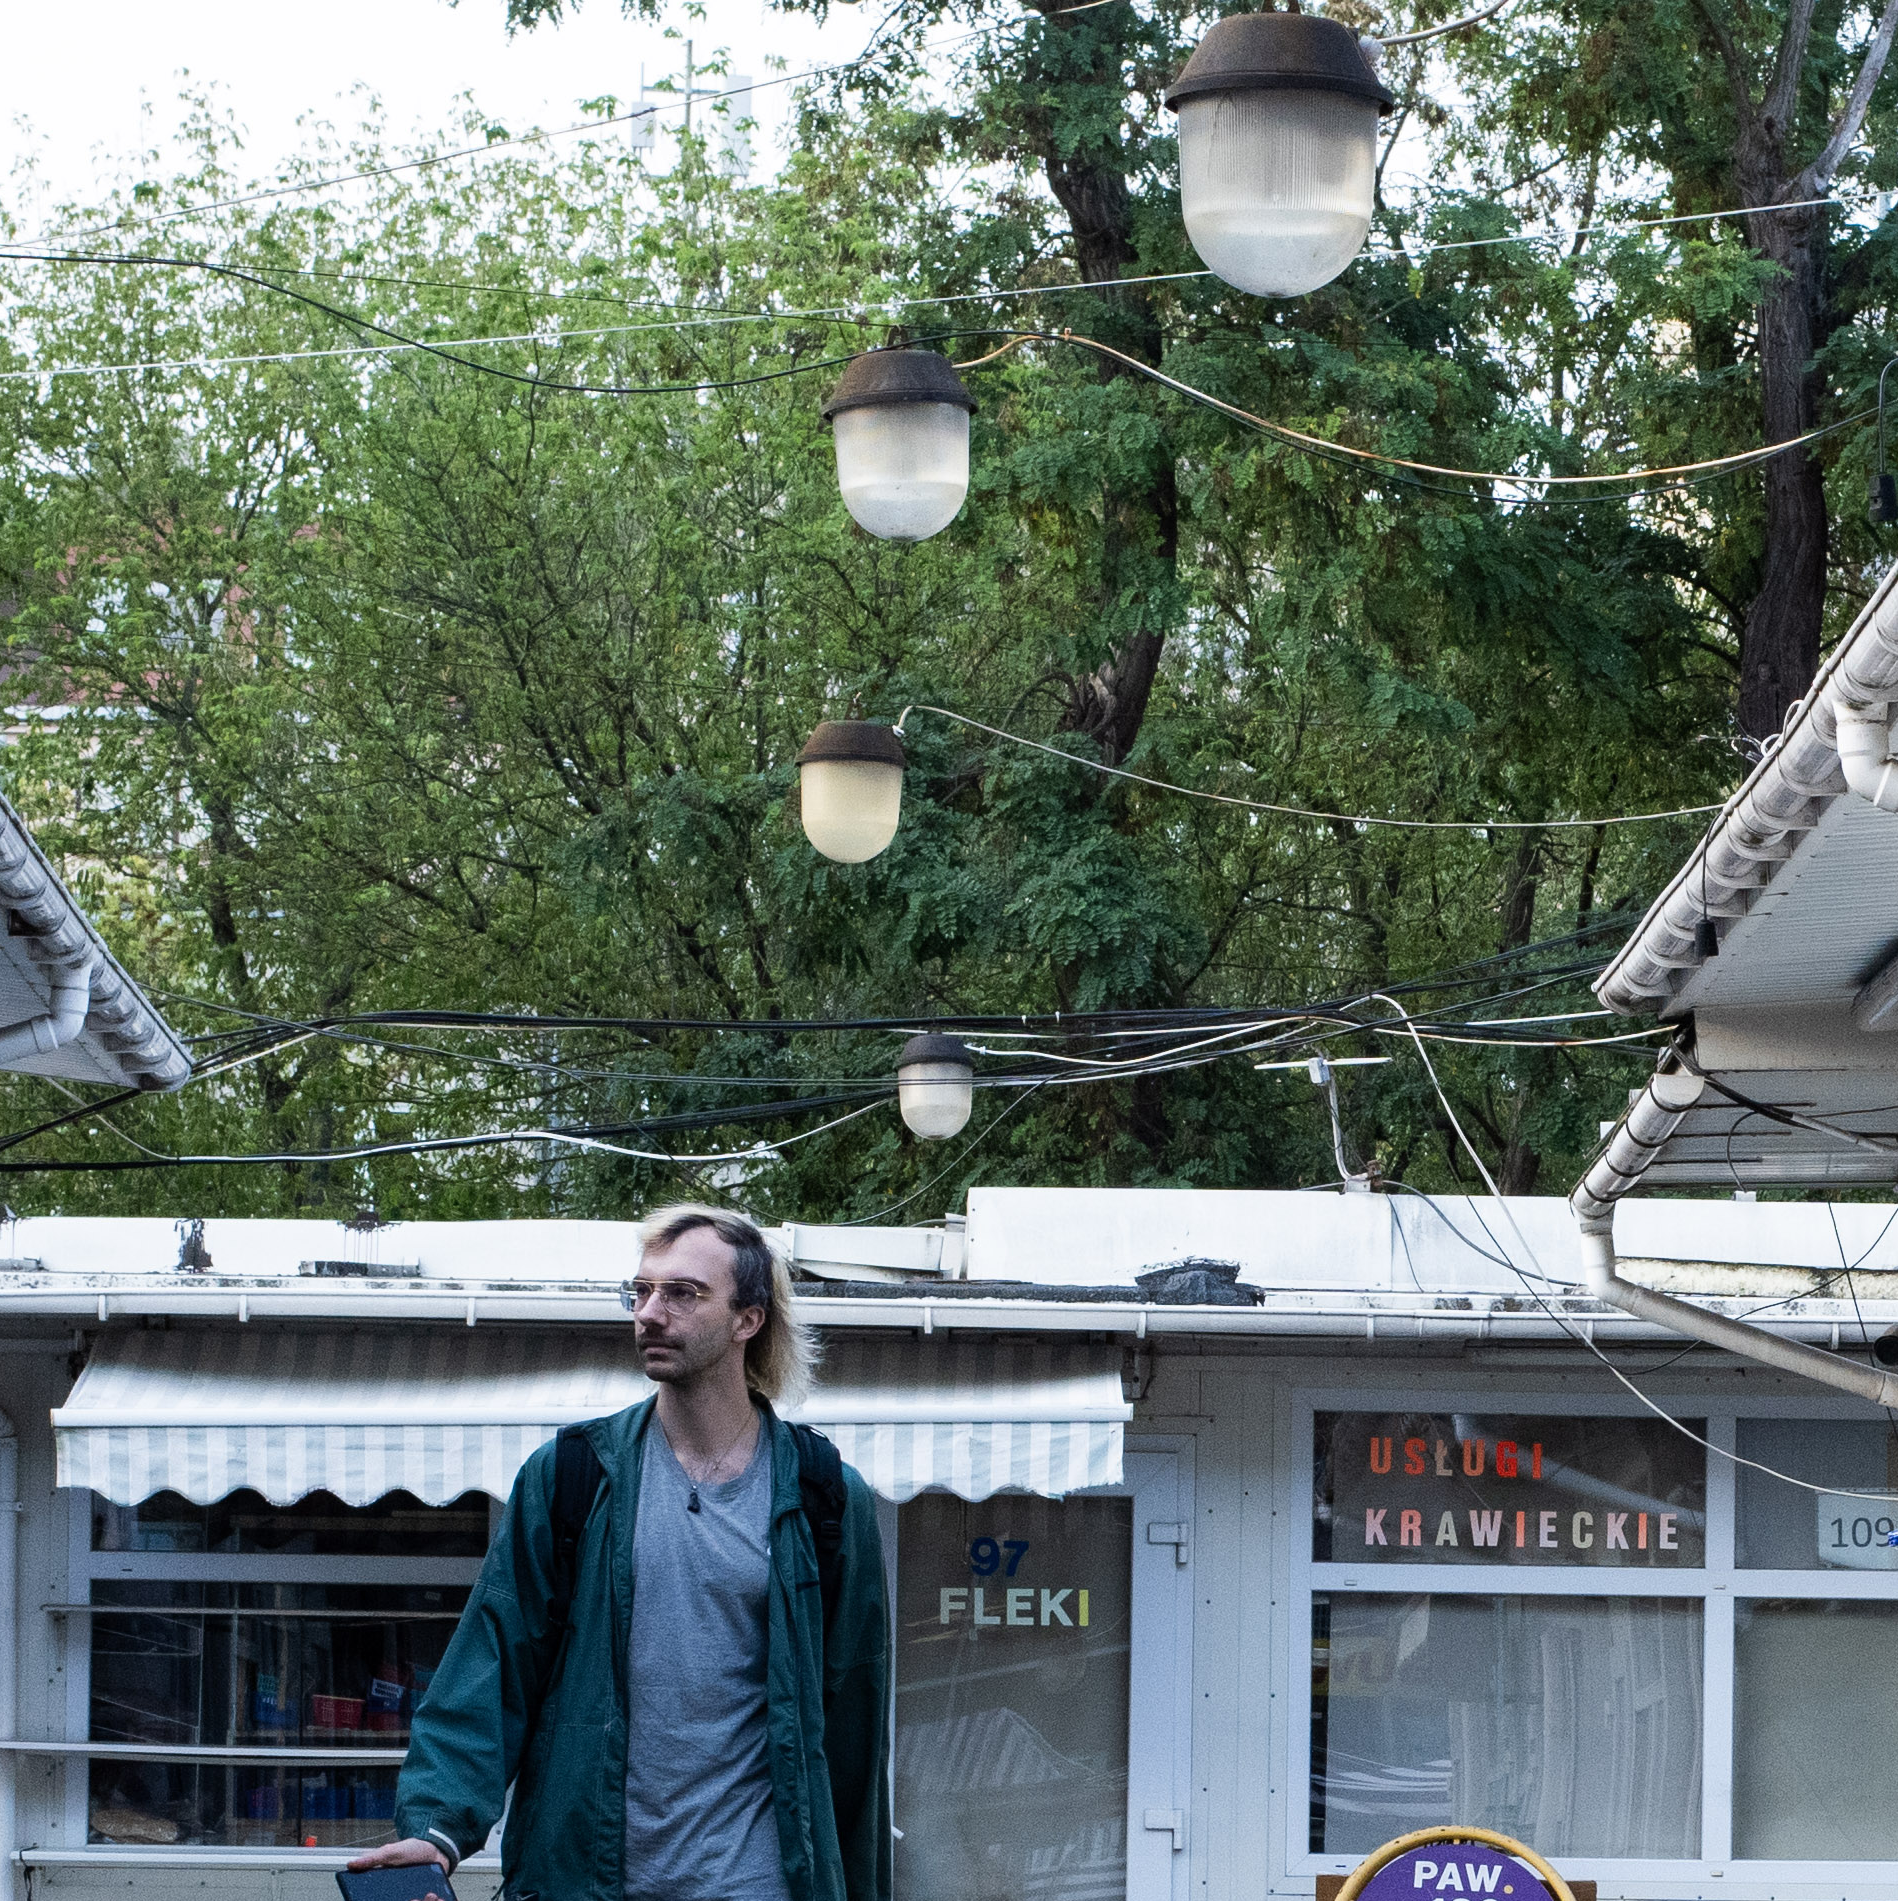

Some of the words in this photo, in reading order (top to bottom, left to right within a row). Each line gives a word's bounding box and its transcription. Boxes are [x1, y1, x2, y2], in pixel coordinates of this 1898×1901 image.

[1370, 1436, 1544, 1480] USŁUGI
[1364, 1508, 1680, 1552] KRAWIECKIE
[1829, 1515, 1891, 1549] 109
[969, 1536, 1030, 1578] 97
[938, 1587, 1090, 1628] FLEKI
